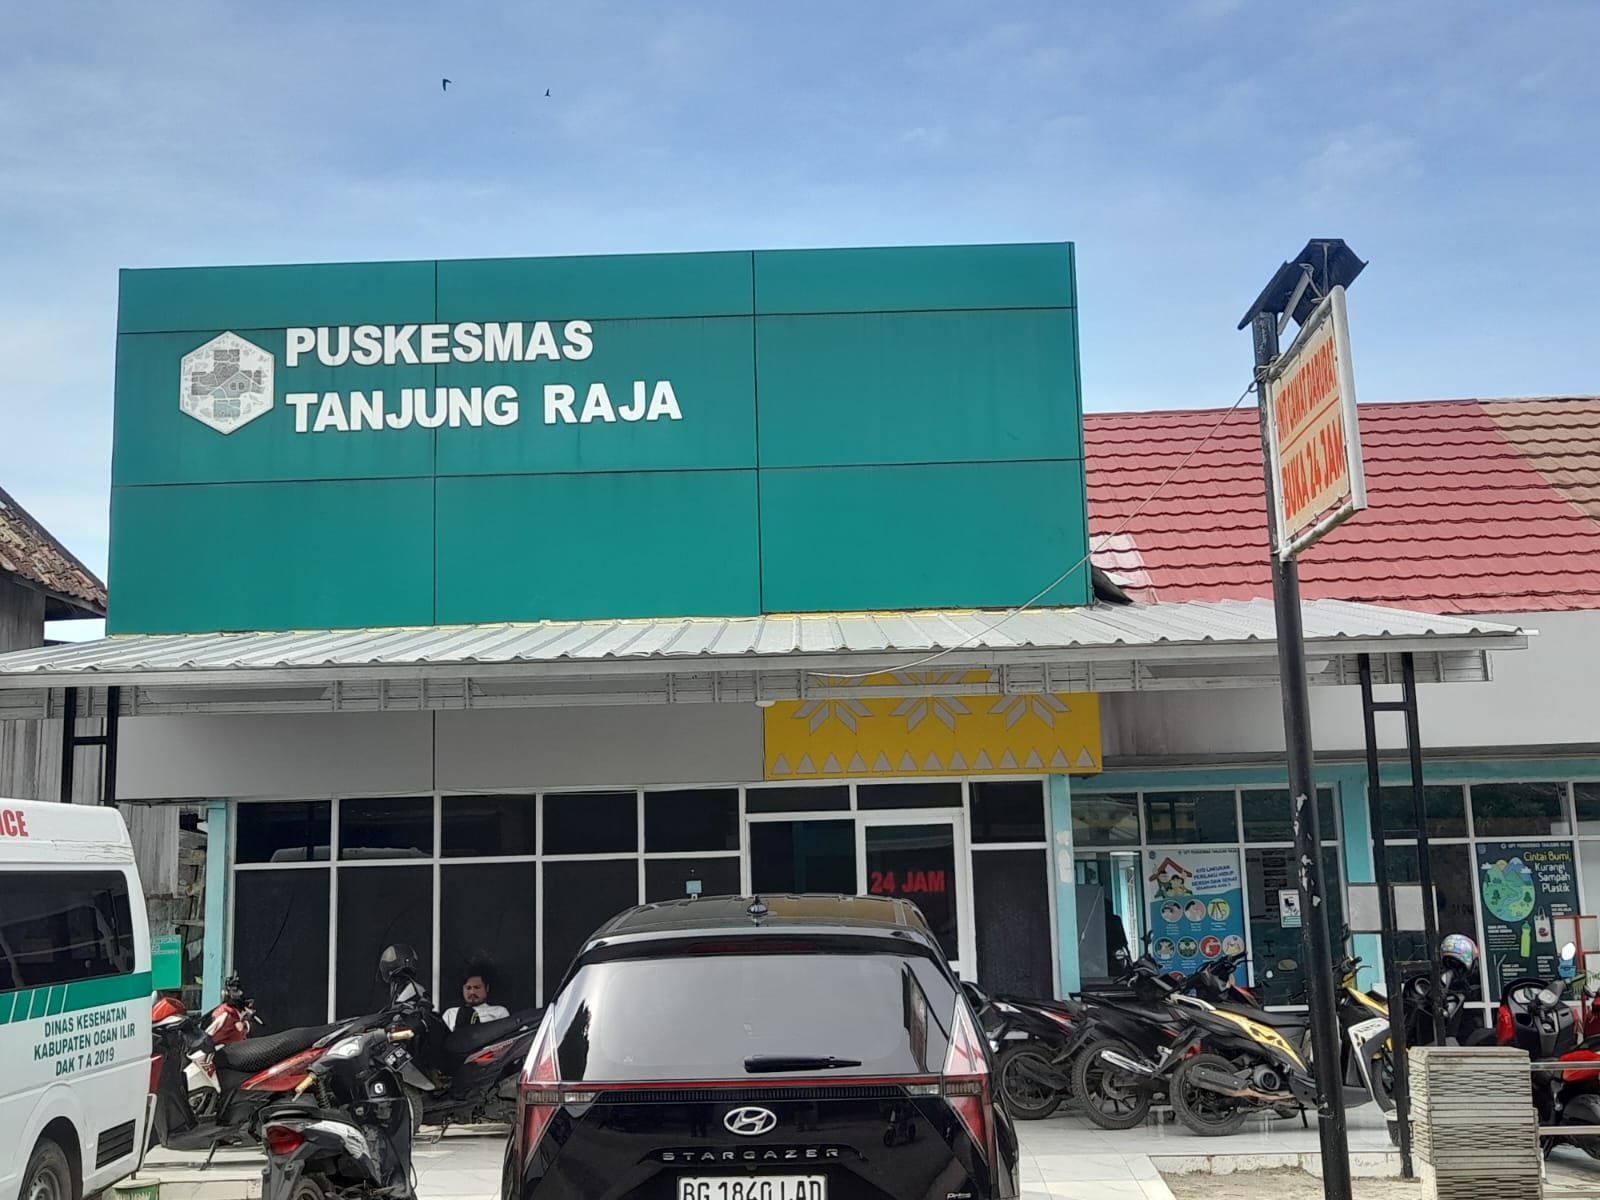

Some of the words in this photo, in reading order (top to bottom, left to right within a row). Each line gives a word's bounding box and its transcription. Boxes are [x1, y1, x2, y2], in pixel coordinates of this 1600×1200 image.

[286, 320, 594, 368] PUSKESMAS
[1287, 370, 1308, 432] GAWAT
[1306, 336, 1337, 411] DARURAT
[286, 385, 519, 433] TANJUNG
[543, 380, 682, 425] RAJA
[1281, 449, 1310, 521] BUKA
[1306, 436, 1323, 502] 24
[1320, 414, 1346, 489] JAM
[1523, 851, 1547, 861] Cintai
[1534, 862, 1566, 874] Kurangi
[870, 870, 896, 893] 24
[902, 870, 945, 893] JAM
[1537, 871, 1571, 883] Sampah
[1541, 882, 1570, 893] Plastik
[44, 1017, 74, 1038] DINAS
[76, 1006, 127, 1031] KESEHATAN
[34, 1033, 91, 1061] KABUPATEN
[93, 1027, 118, 1046] OGAN
[120, 1022, 136, 1040] ILIR
[55, 1057, 75, 1076] DAK
[78, 1055, 84, 1070] T
[85, 1053, 92, 1068] A
[94, 1046, 115, 1066] 2019
[662, 1148, 839, 1161] STARGAZER
[683, 1181, 710, 1200] BG
[781, 1180, 823, 1200] LAD
